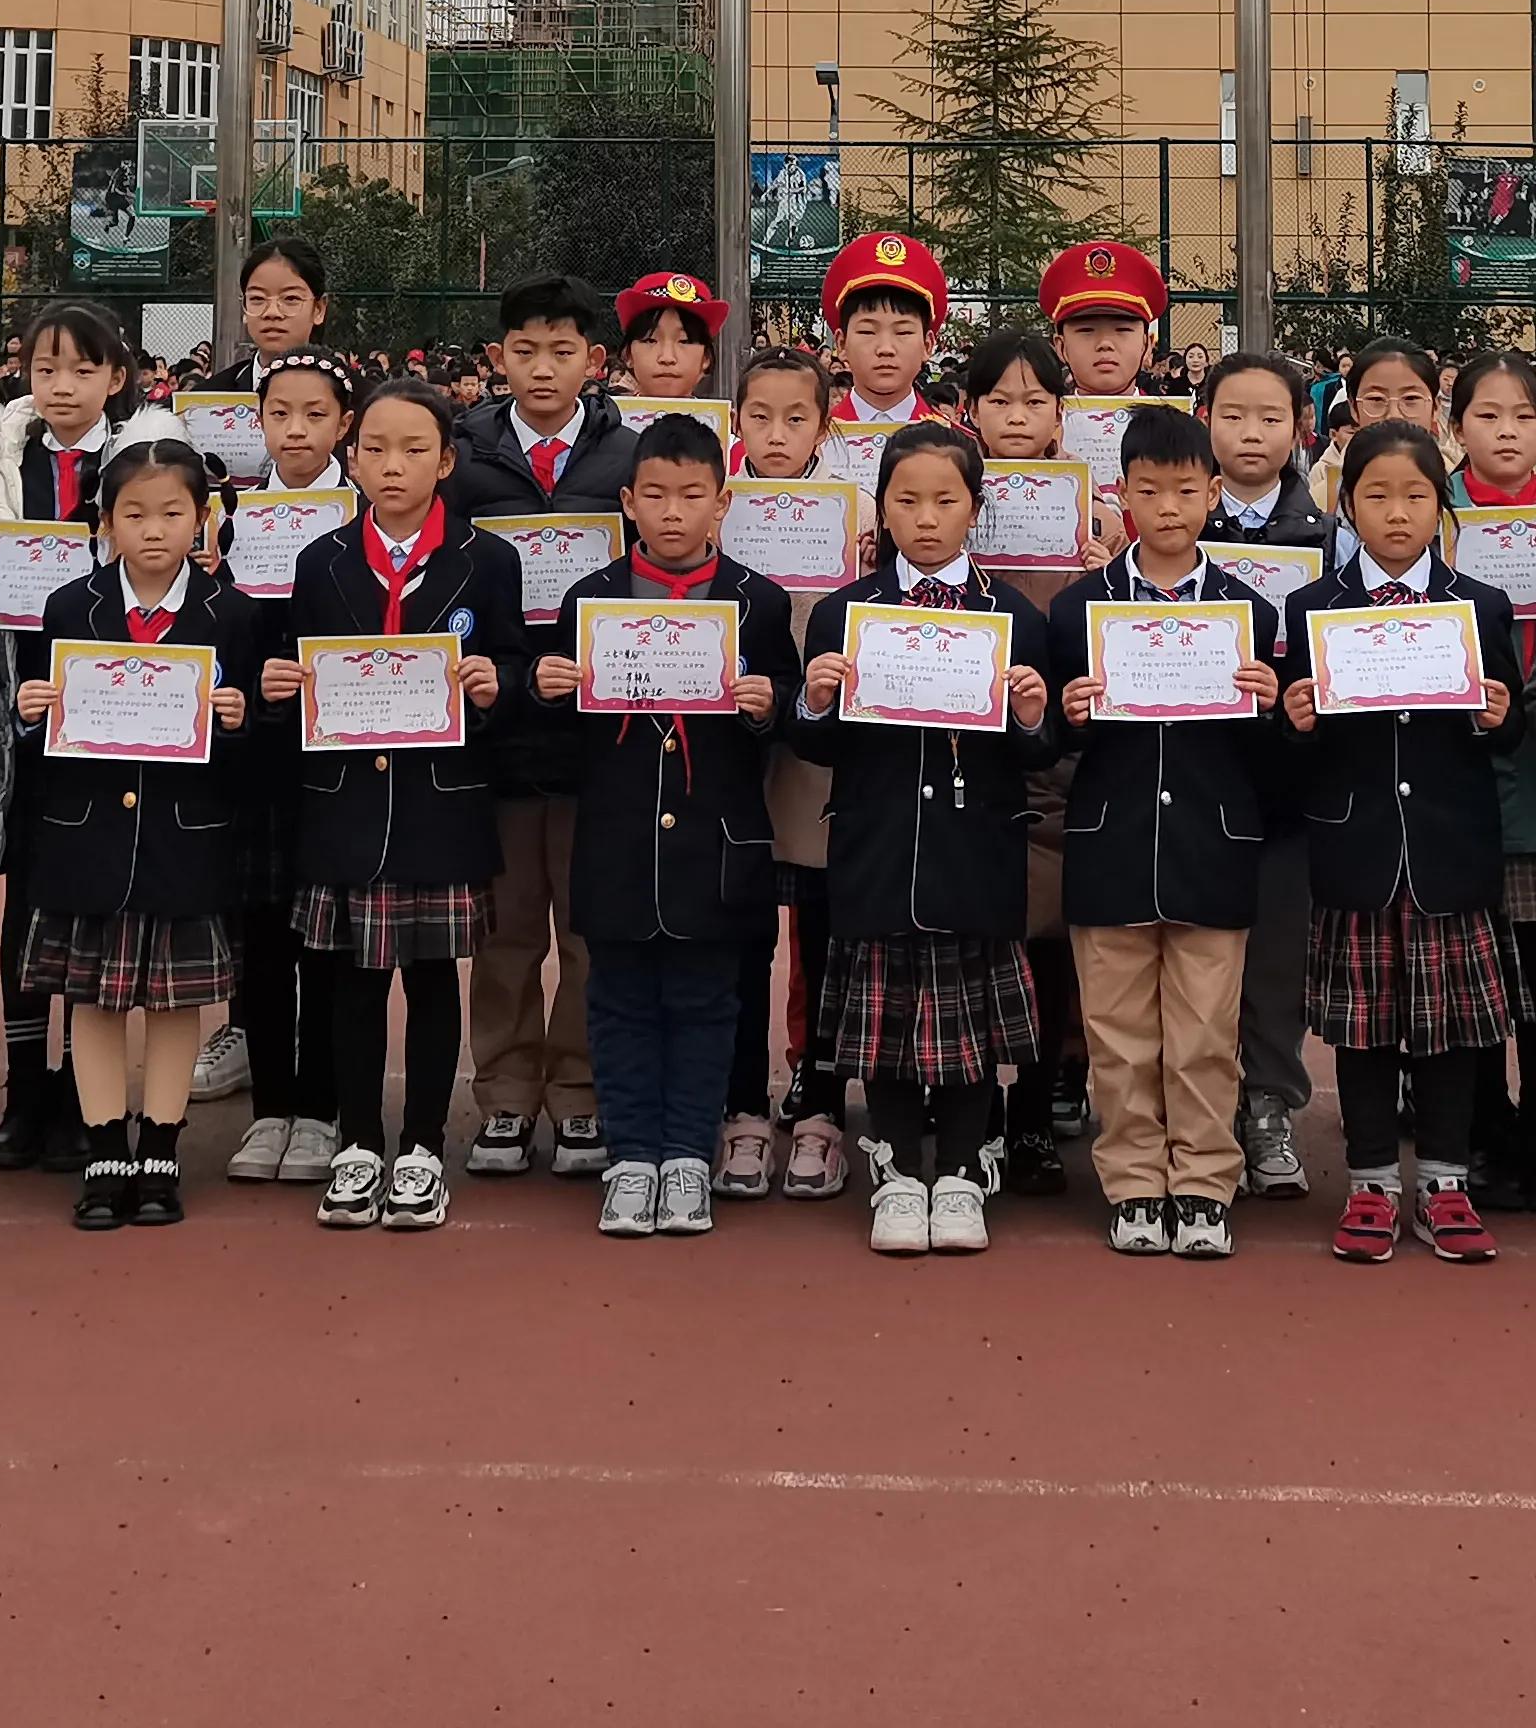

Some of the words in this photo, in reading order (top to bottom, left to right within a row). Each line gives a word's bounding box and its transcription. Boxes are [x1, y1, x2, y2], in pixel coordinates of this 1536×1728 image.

[224, 417, 261, 431] 奖状
[998, 488, 1037, 502] 奖状
[764, 508, 805, 521] 奖状
[262, 518, 303, 532] 奖状
[29, 549, 69, 563] 奖状
[531, 542, 571, 556] 奖状
[637, 632, 681, 646] 奖状
[906, 638, 951, 653] 奖状
[1150, 632, 1194, 647] 奖状
[362, 663, 403, 677] 奖状
[112, 672, 155, 687] 奖状
